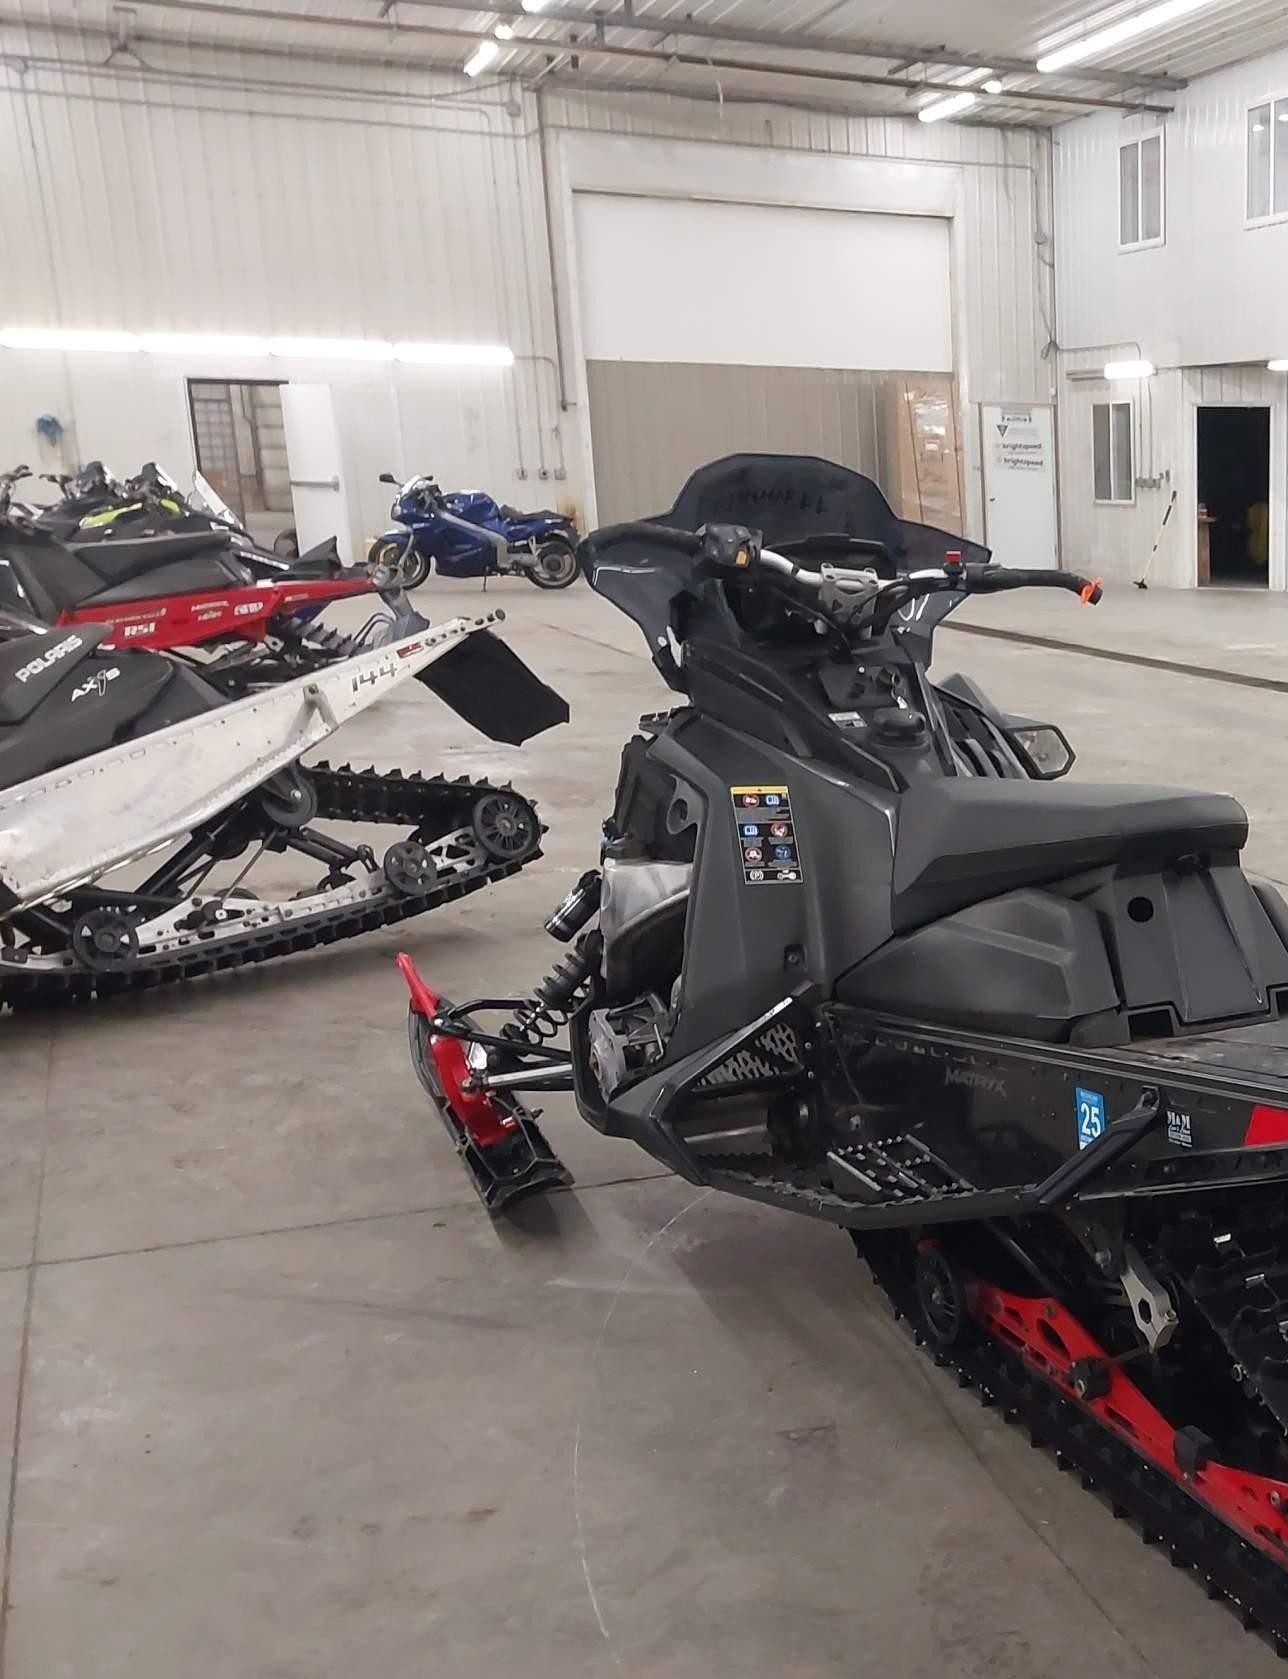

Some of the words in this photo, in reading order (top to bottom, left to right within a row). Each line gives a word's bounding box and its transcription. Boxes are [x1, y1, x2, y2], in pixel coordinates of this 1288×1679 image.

[15, 634, 83, 683] POLARIS
[351, 662, 398, 693] 144
[1080, 1102, 1102, 1138] 25
